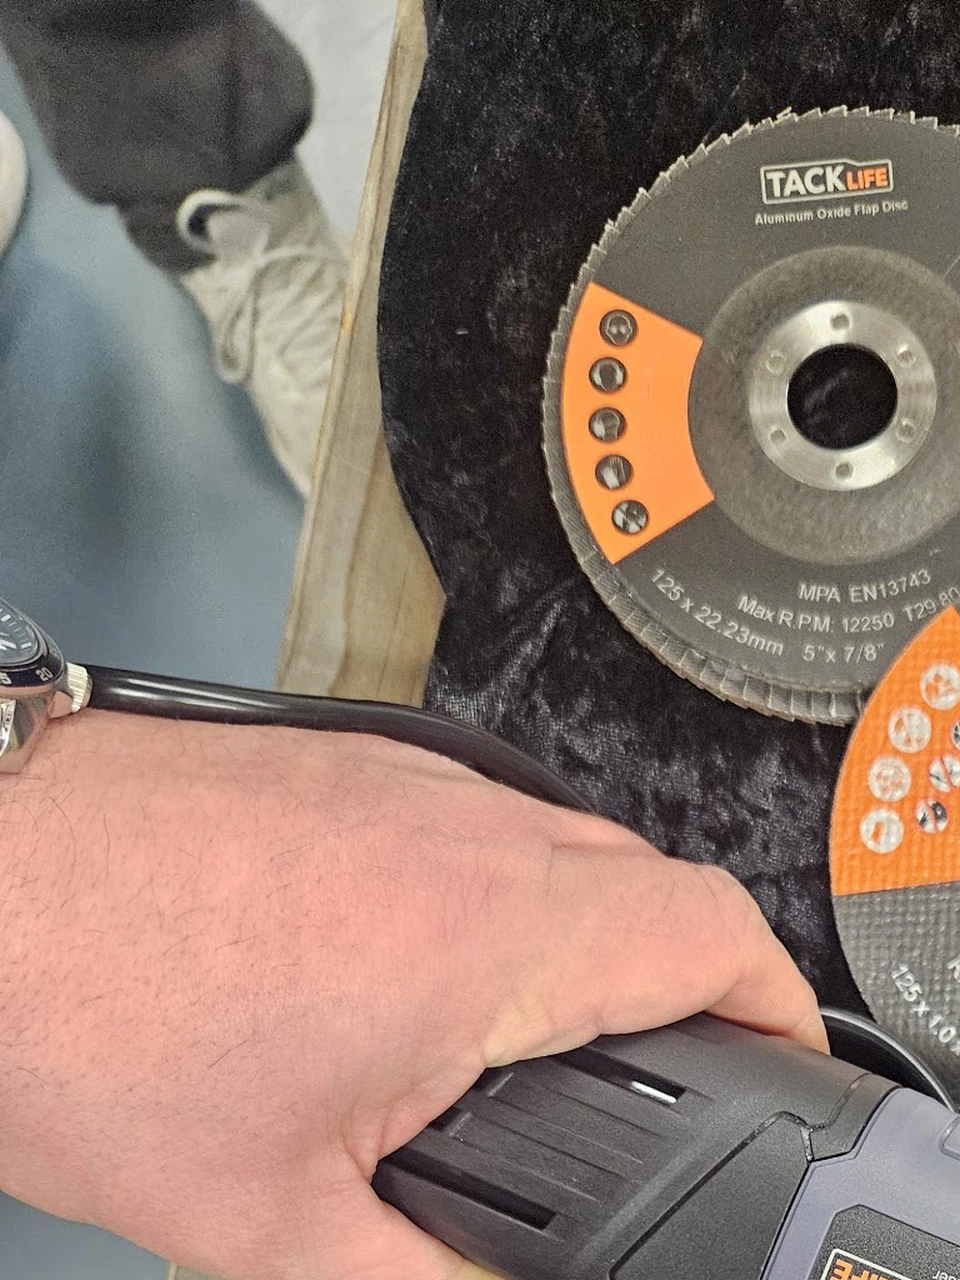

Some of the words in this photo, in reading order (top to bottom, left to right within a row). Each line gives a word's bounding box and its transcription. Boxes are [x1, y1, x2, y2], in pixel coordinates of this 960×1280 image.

[754, 210, 814, 226] Aluminum
[817, 207, 851, 220] Oxide
[854, 204, 880, 217] Flap
[882, 200, 909, 213] Disc
[798, 581, 842, 603] MPA
[850, 568, 932, 603] EN13743
[651, 569, 685, 602] 125
[680, 598, 695, 613] x
[695, 605, 785, 657] 22.23mm
[737, 595, 775, 624] Max
[842, 612, 896, 634] 12250
[903, 599, 937, 622] T29
[36, 667, 54, 682] 20
[891, 964, 923, 1002] 125
[911, 1000, 930, 1018] x
[928, 1014, 956, 1044] 1.0
